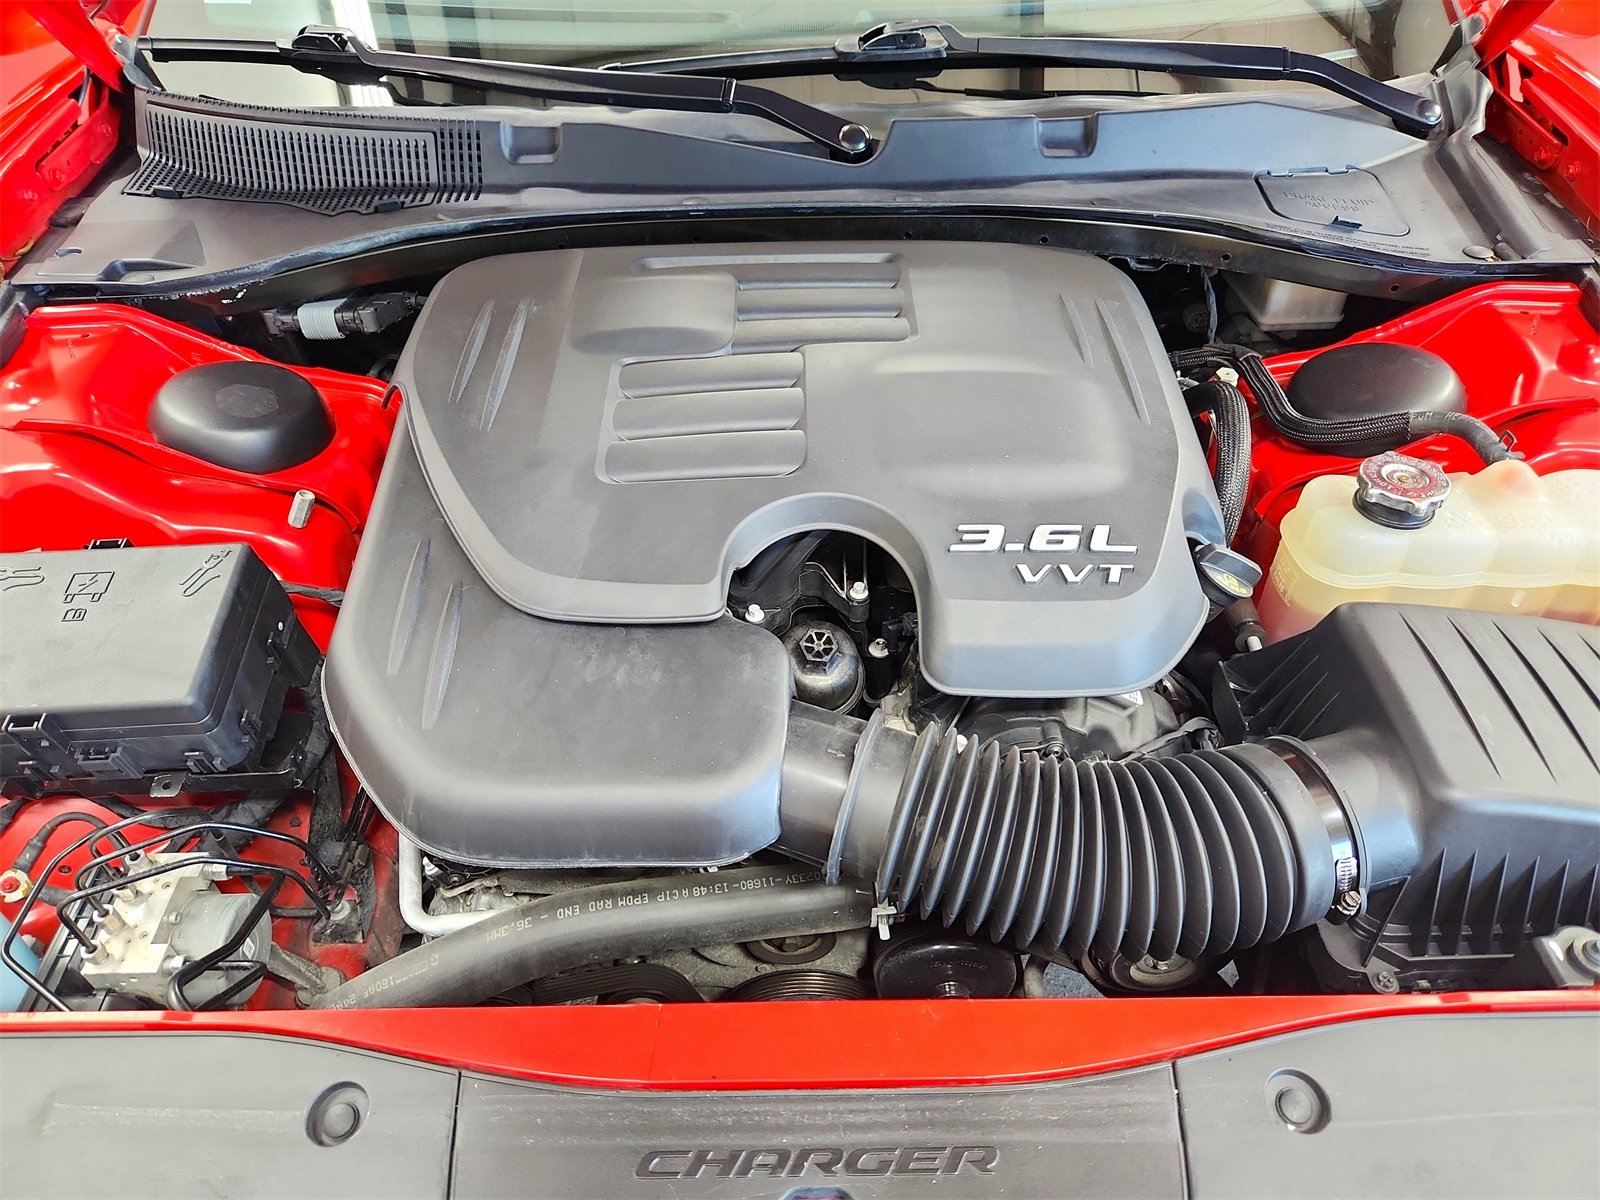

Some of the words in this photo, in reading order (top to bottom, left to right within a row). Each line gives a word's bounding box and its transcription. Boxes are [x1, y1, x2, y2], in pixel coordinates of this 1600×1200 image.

[948, 524, 1139, 555] 3.6L
[1014, 563, 1135, 586] VVT
[588, 898, 613, 913] RAD
[617, 893, 649, 907] EPDM
[556, 904, 581, 919] END
[633, 1146, 999, 1179] CHARGER
